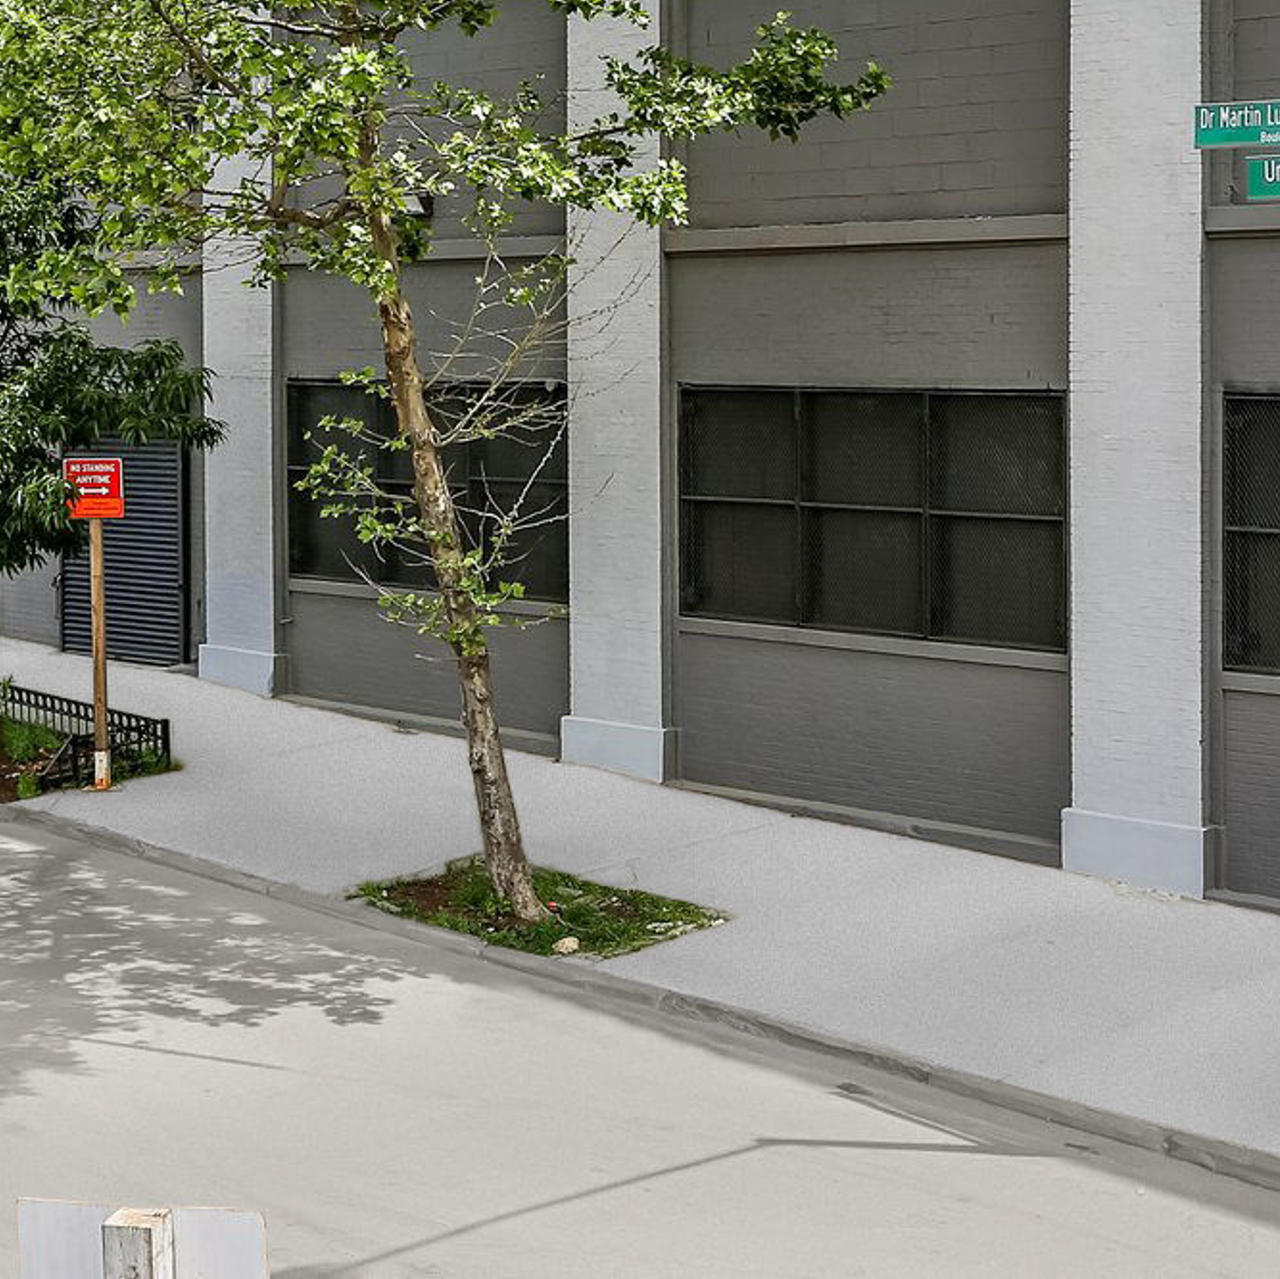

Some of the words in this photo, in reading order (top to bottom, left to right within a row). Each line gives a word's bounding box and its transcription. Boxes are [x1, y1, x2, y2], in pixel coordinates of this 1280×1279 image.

[1199, 107, 1215, 129] Dr
[1220, 104, 1262, 128] Martin
[71, 463, 81, 472] NO
[81, 463, 115, 472] STANDING
[75, 474, 112, 484] ANYTIME
